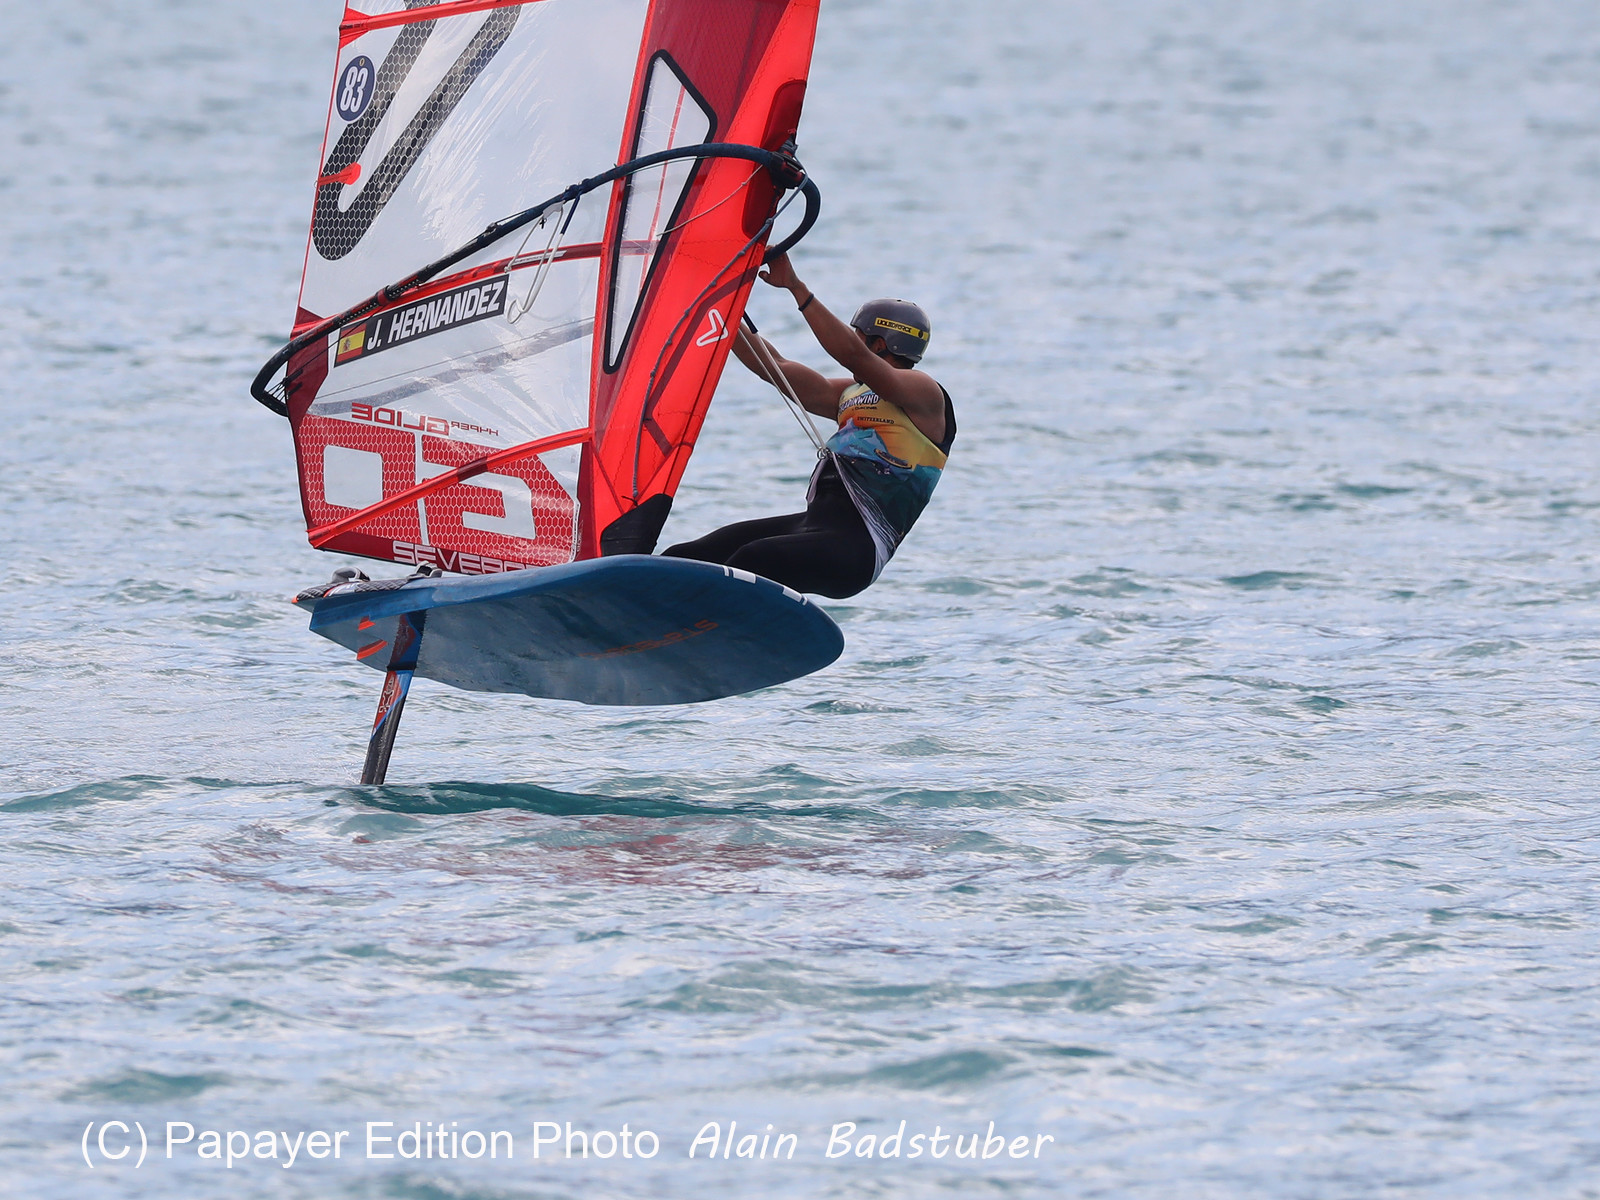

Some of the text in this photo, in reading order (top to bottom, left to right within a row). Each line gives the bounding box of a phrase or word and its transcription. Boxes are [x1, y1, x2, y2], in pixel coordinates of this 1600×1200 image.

[340, 66, 369, 113] 83
[366, 281, 505, 350] J. HERNANDEZ
[393, 540, 546, 575] SEVER
